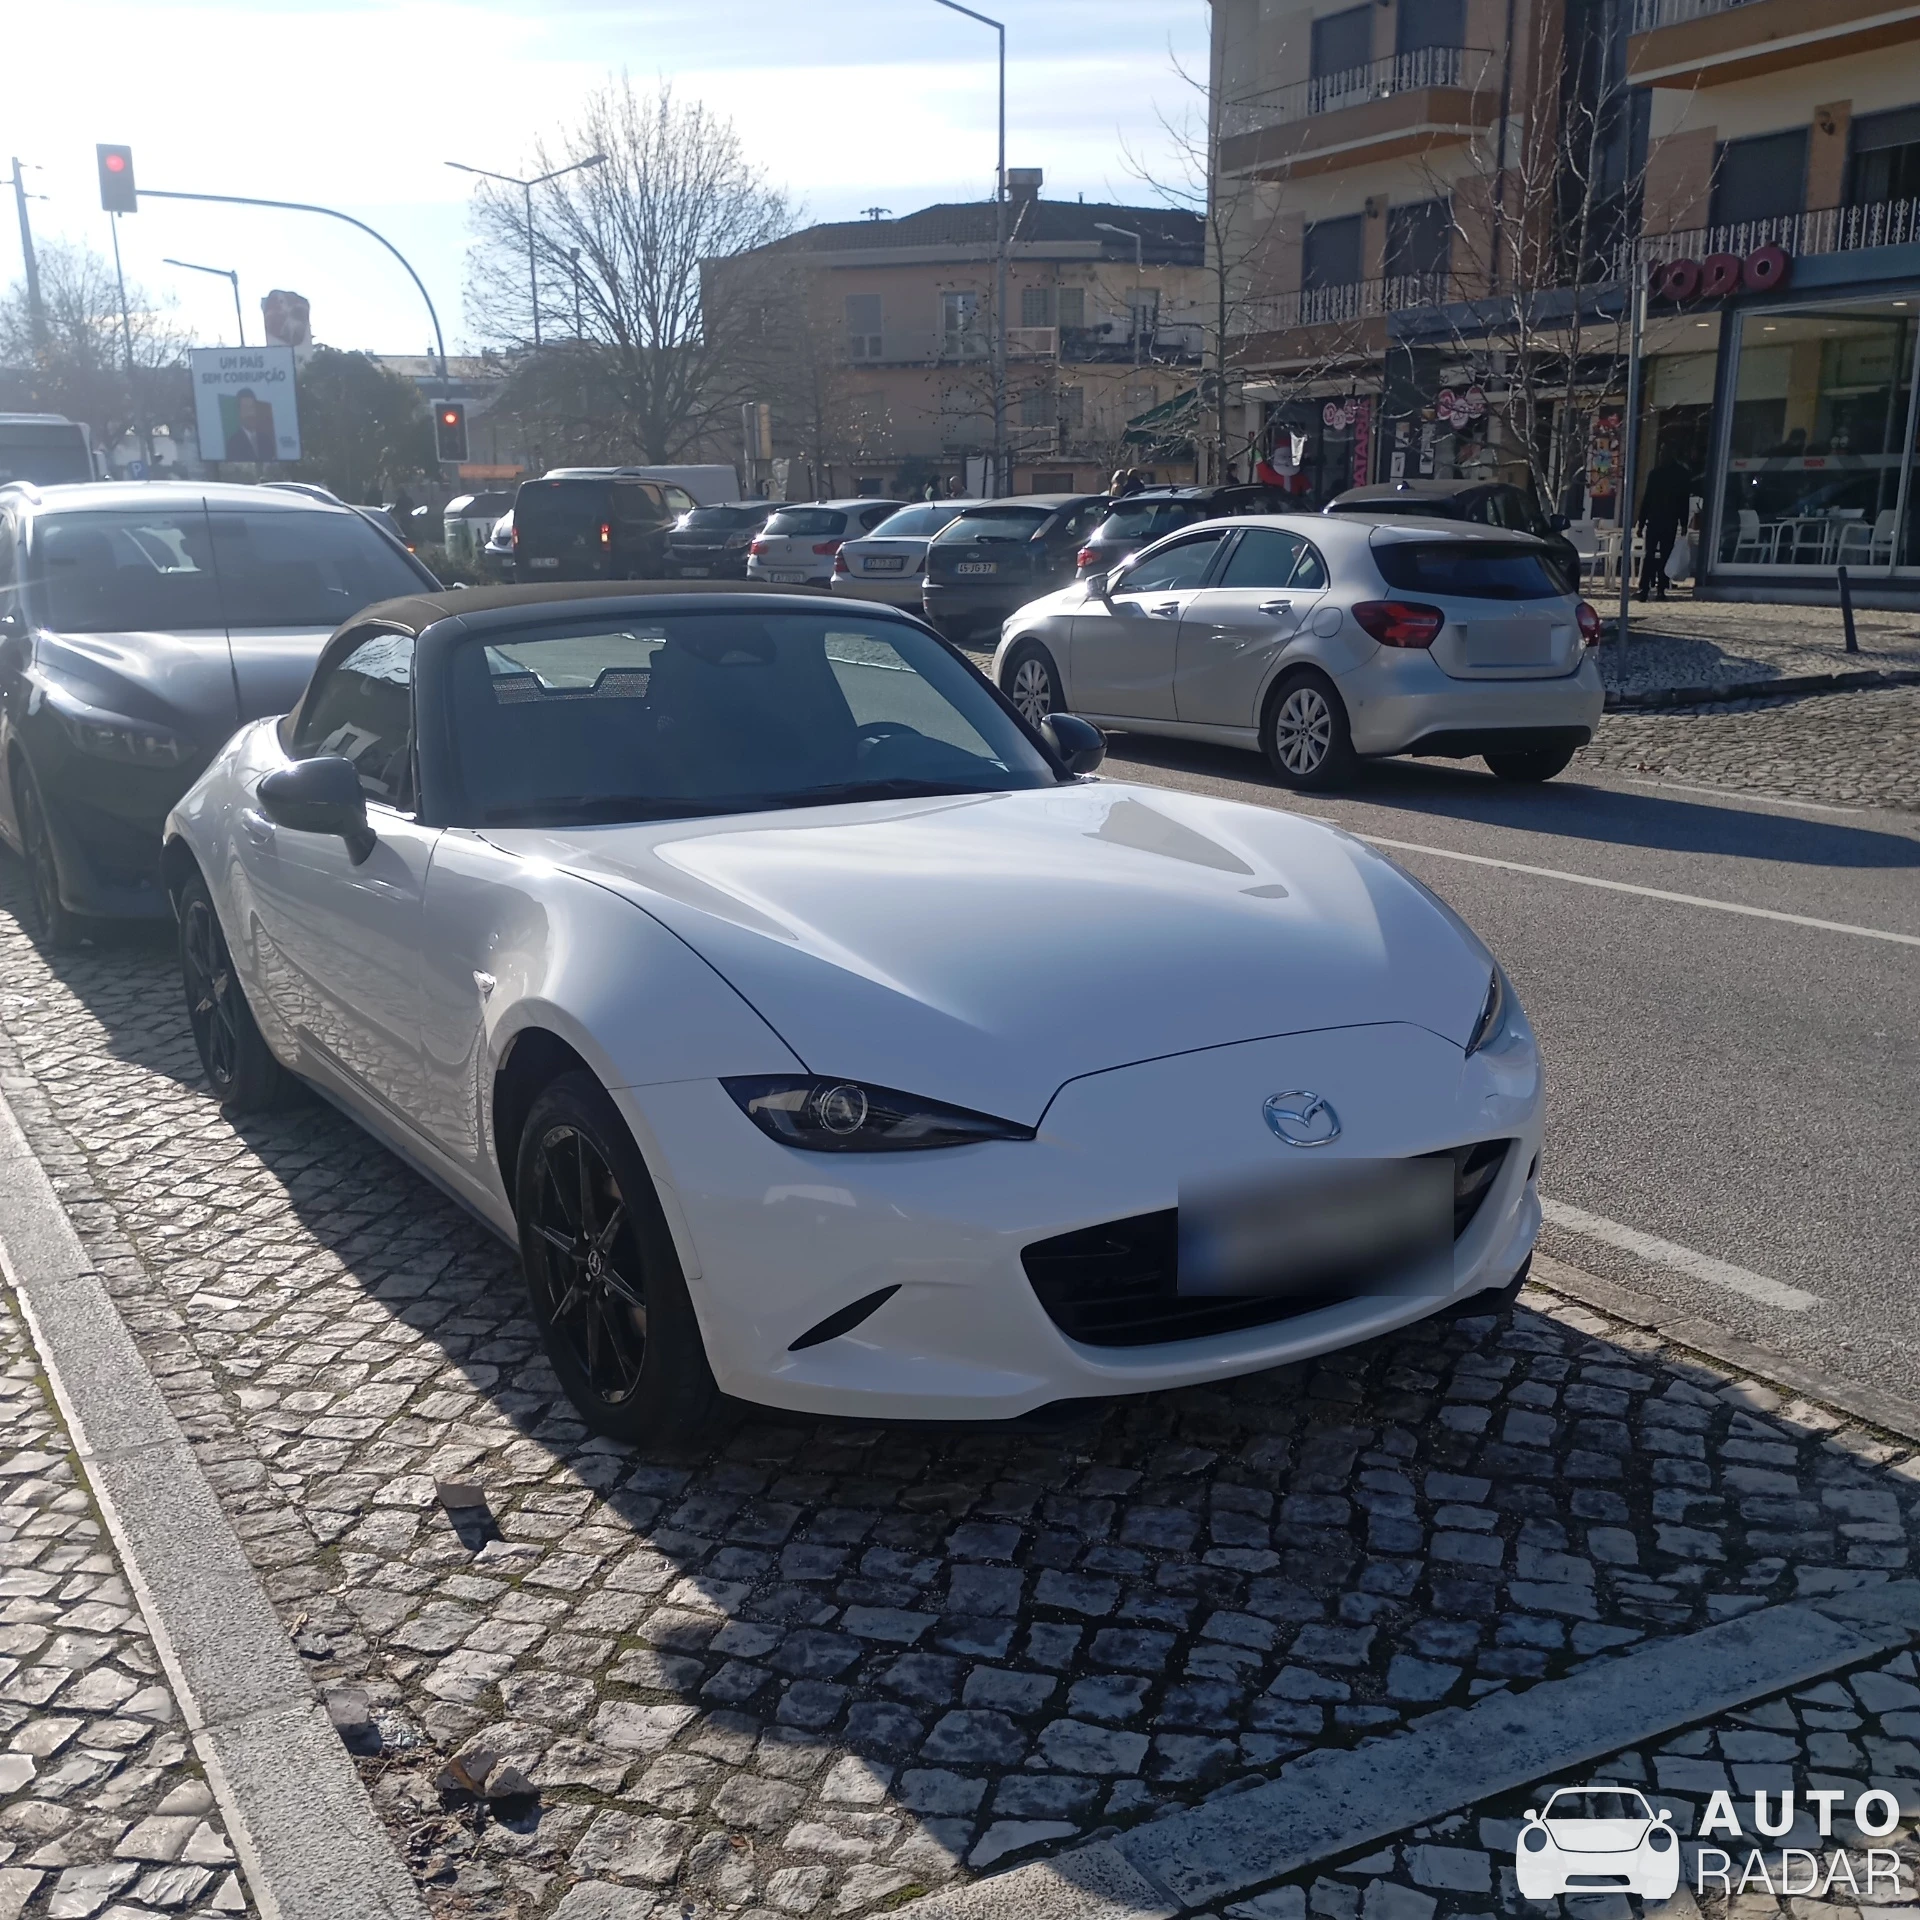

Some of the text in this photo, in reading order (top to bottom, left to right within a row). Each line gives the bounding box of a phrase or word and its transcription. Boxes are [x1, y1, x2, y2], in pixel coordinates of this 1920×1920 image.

[220, 352, 264, 369] UM PAÍS
[202, 367, 286, 386] SEM CORRUPÇÃO
